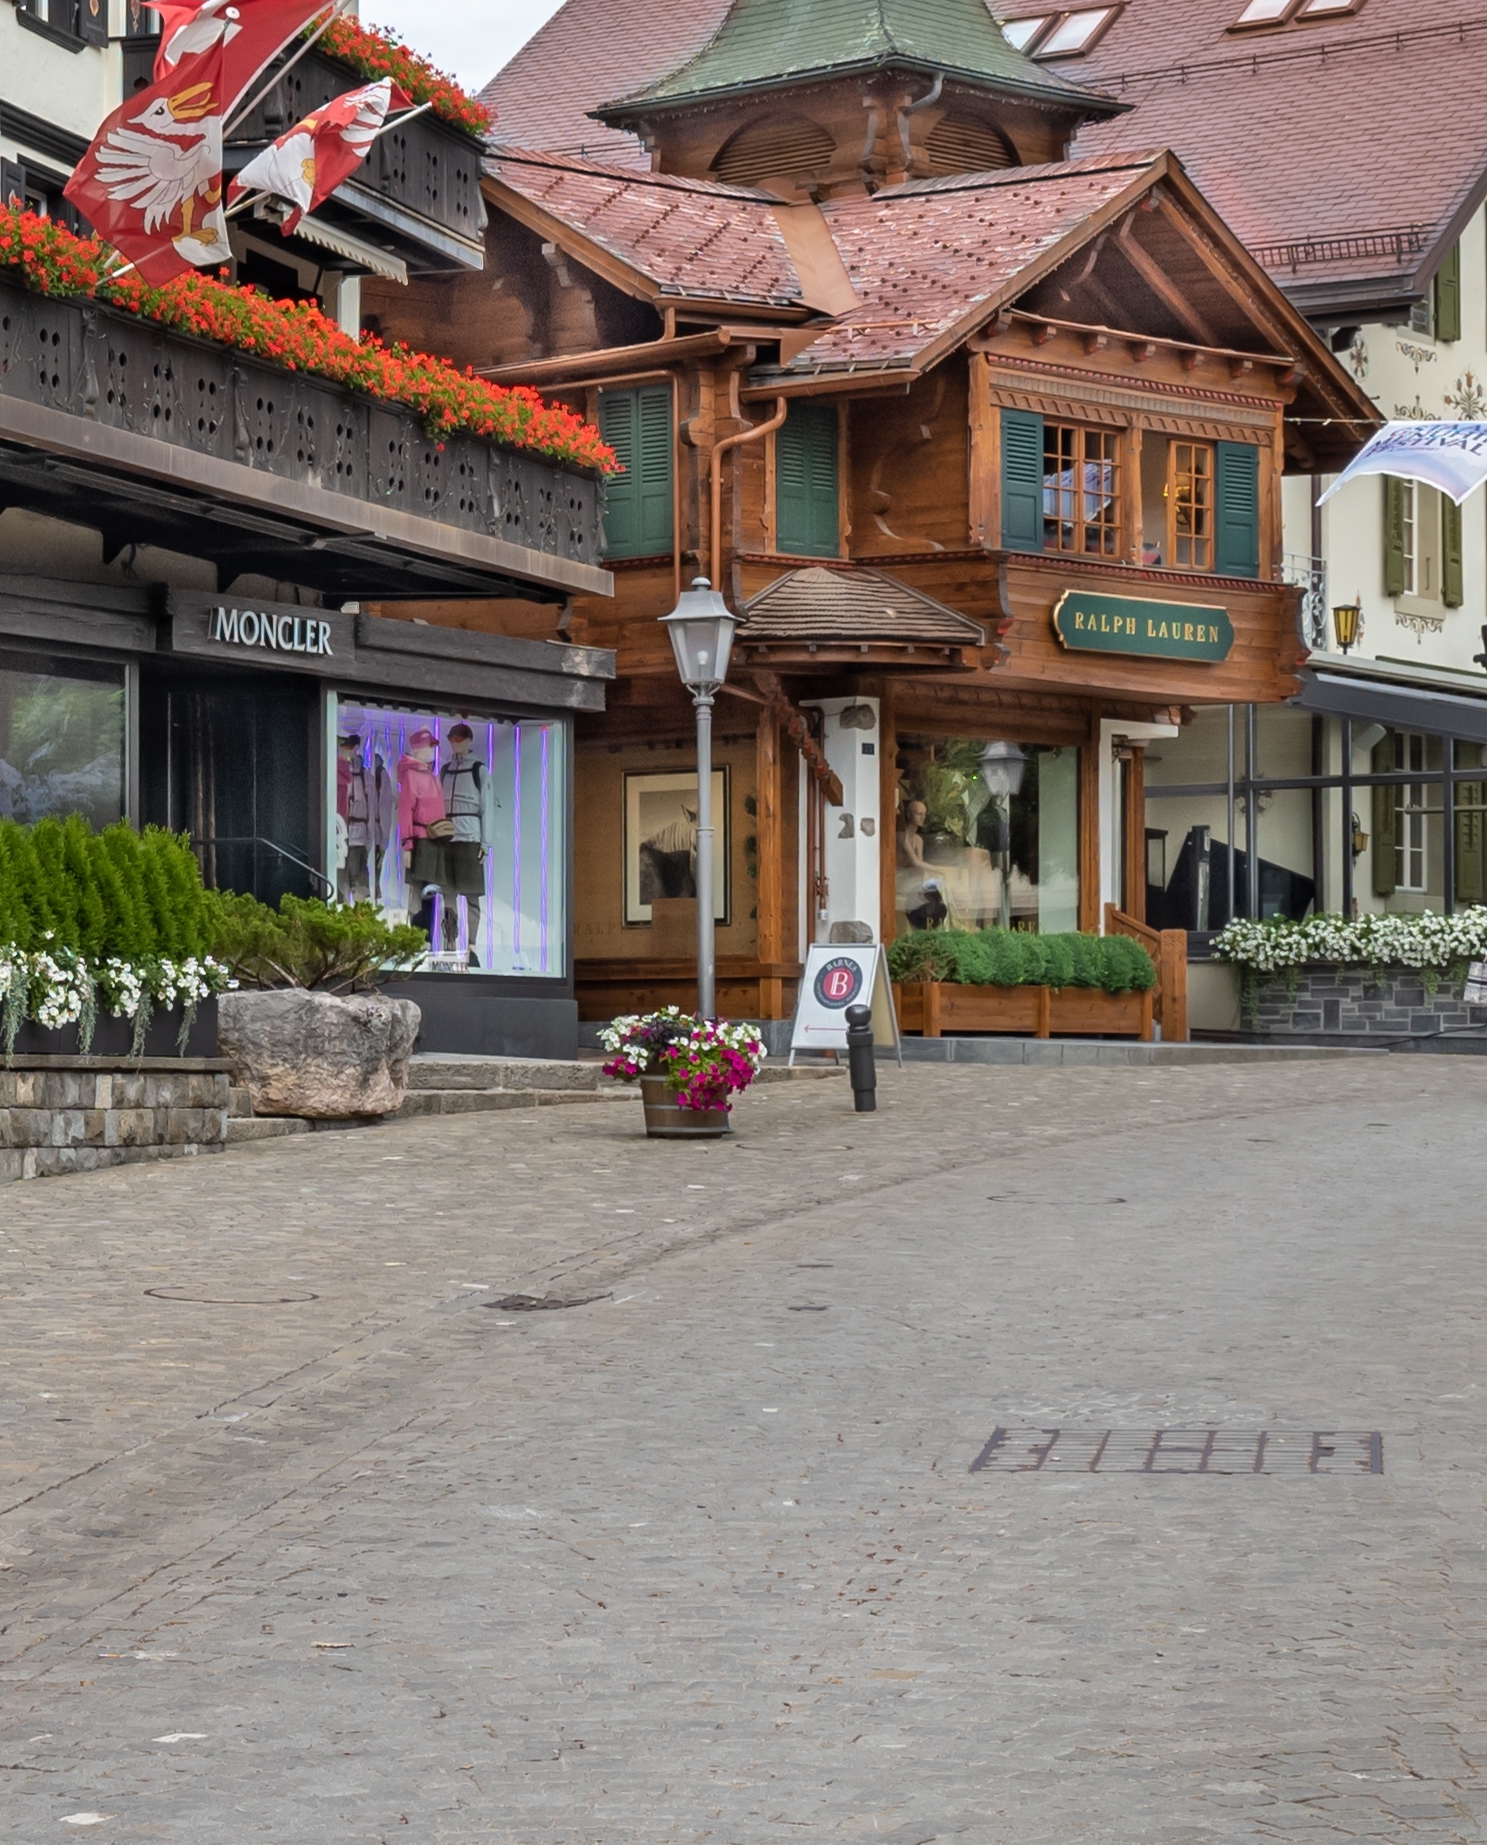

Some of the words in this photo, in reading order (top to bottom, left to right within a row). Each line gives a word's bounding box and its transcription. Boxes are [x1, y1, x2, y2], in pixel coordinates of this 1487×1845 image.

[213, 606, 333, 656] MONCLER
[1074, 610, 1137, 639] RALPH
[1146, 616, 1221, 644] LAUREN
[830, 971, 849, 996] B
